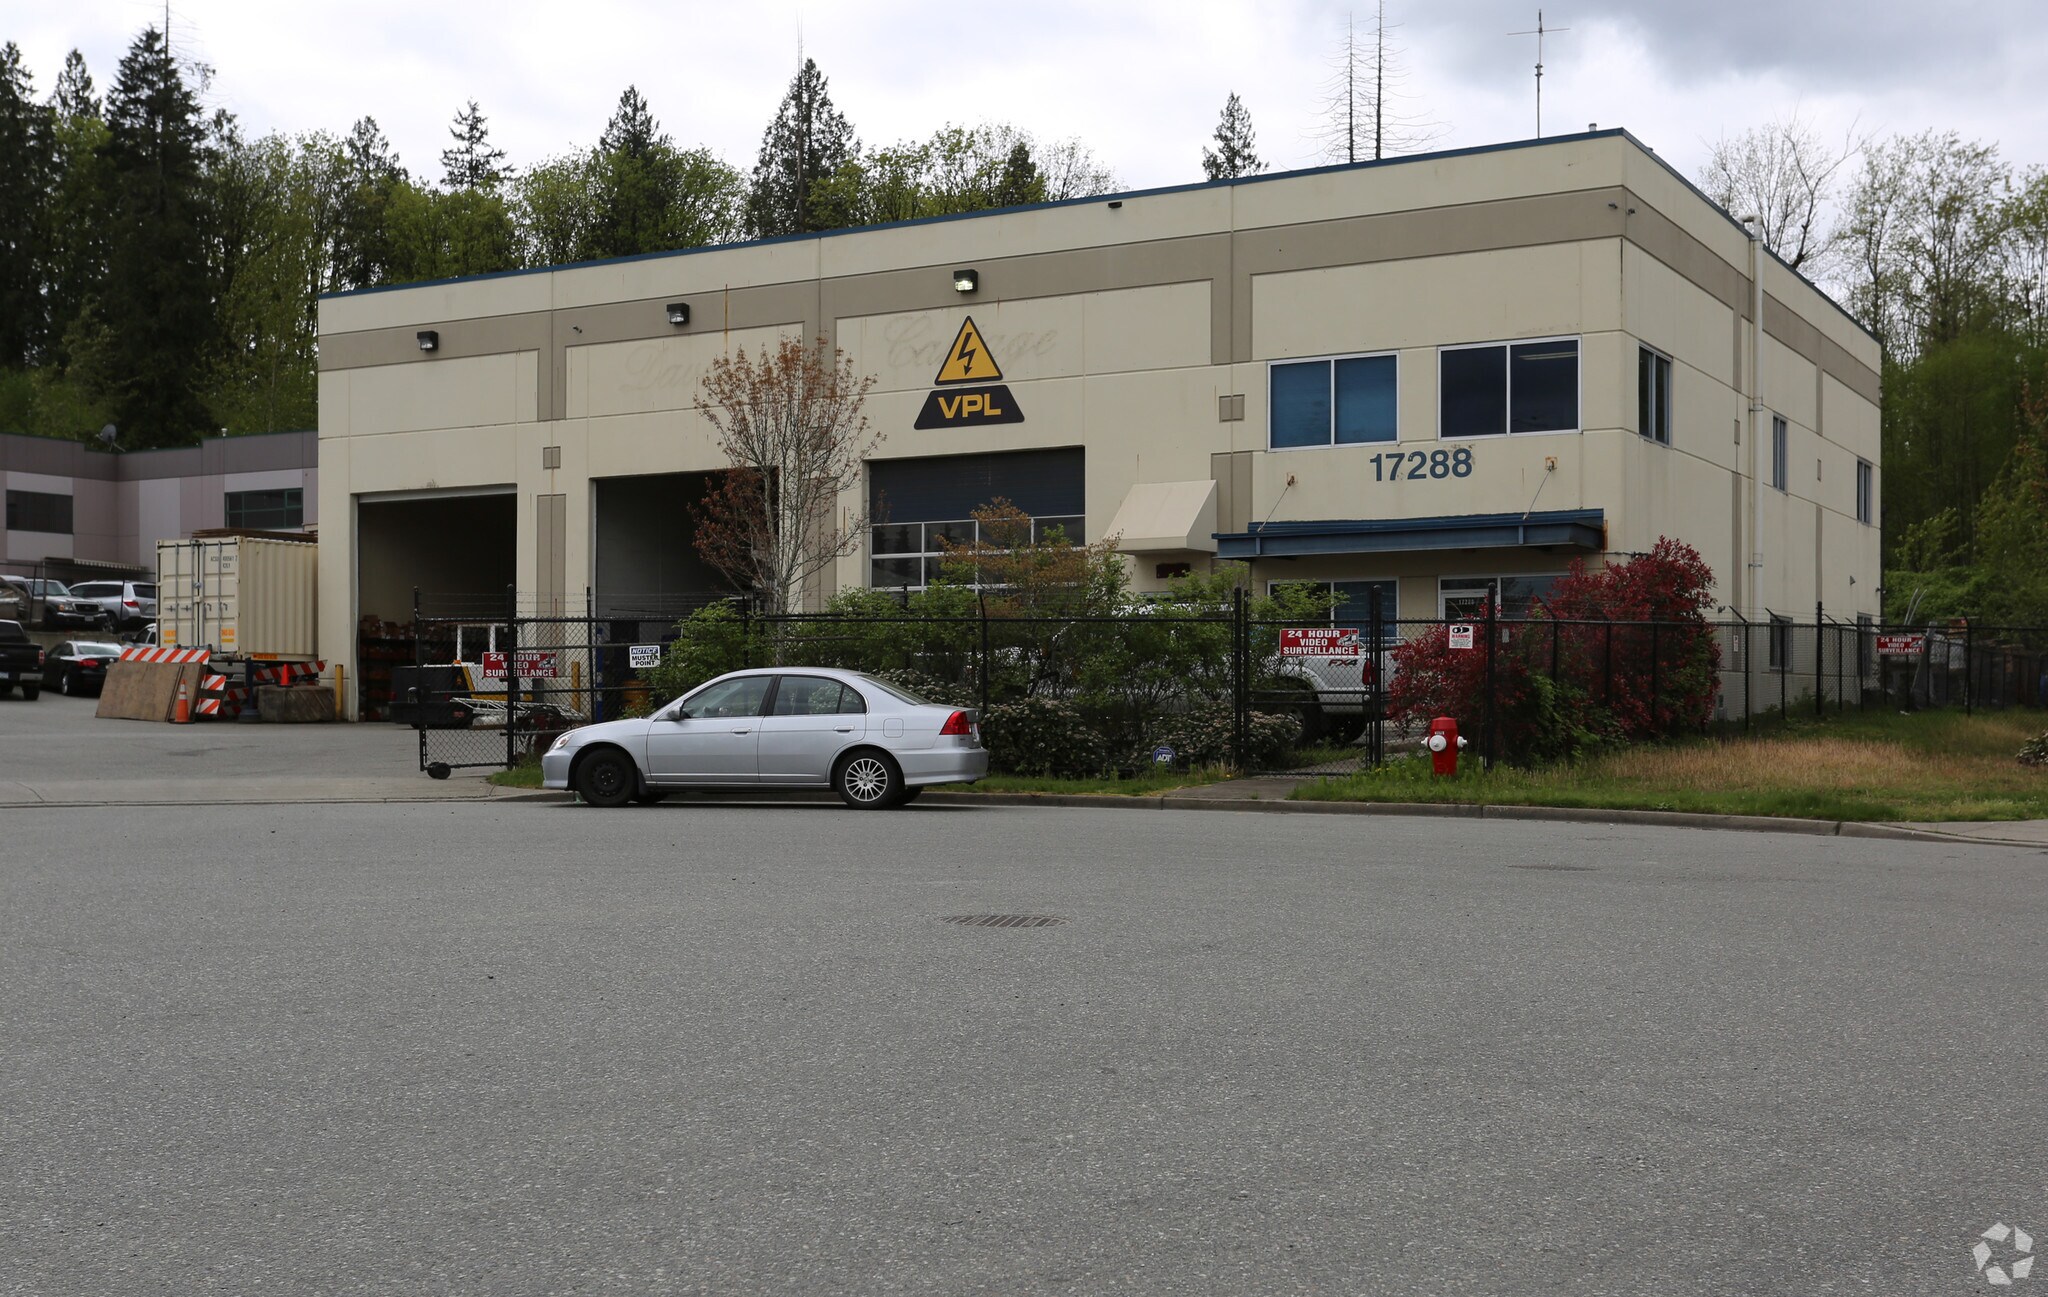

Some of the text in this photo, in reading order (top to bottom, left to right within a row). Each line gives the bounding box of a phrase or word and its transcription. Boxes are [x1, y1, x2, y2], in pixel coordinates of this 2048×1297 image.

[937, 393, 1002, 419] VPL
[1369, 448, 1473, 482] 17288
[1287, 630, 1340, 638] 24 HOUR
[1299, 638, 1328, 646] VIDEO
[1283, 646, 1355, 655] SURVEILLANCE
[489, 653, 505, 661] 24
[1328, 659, 1359, 667] FX4
[1157, 754, 1172, 763] ADT
